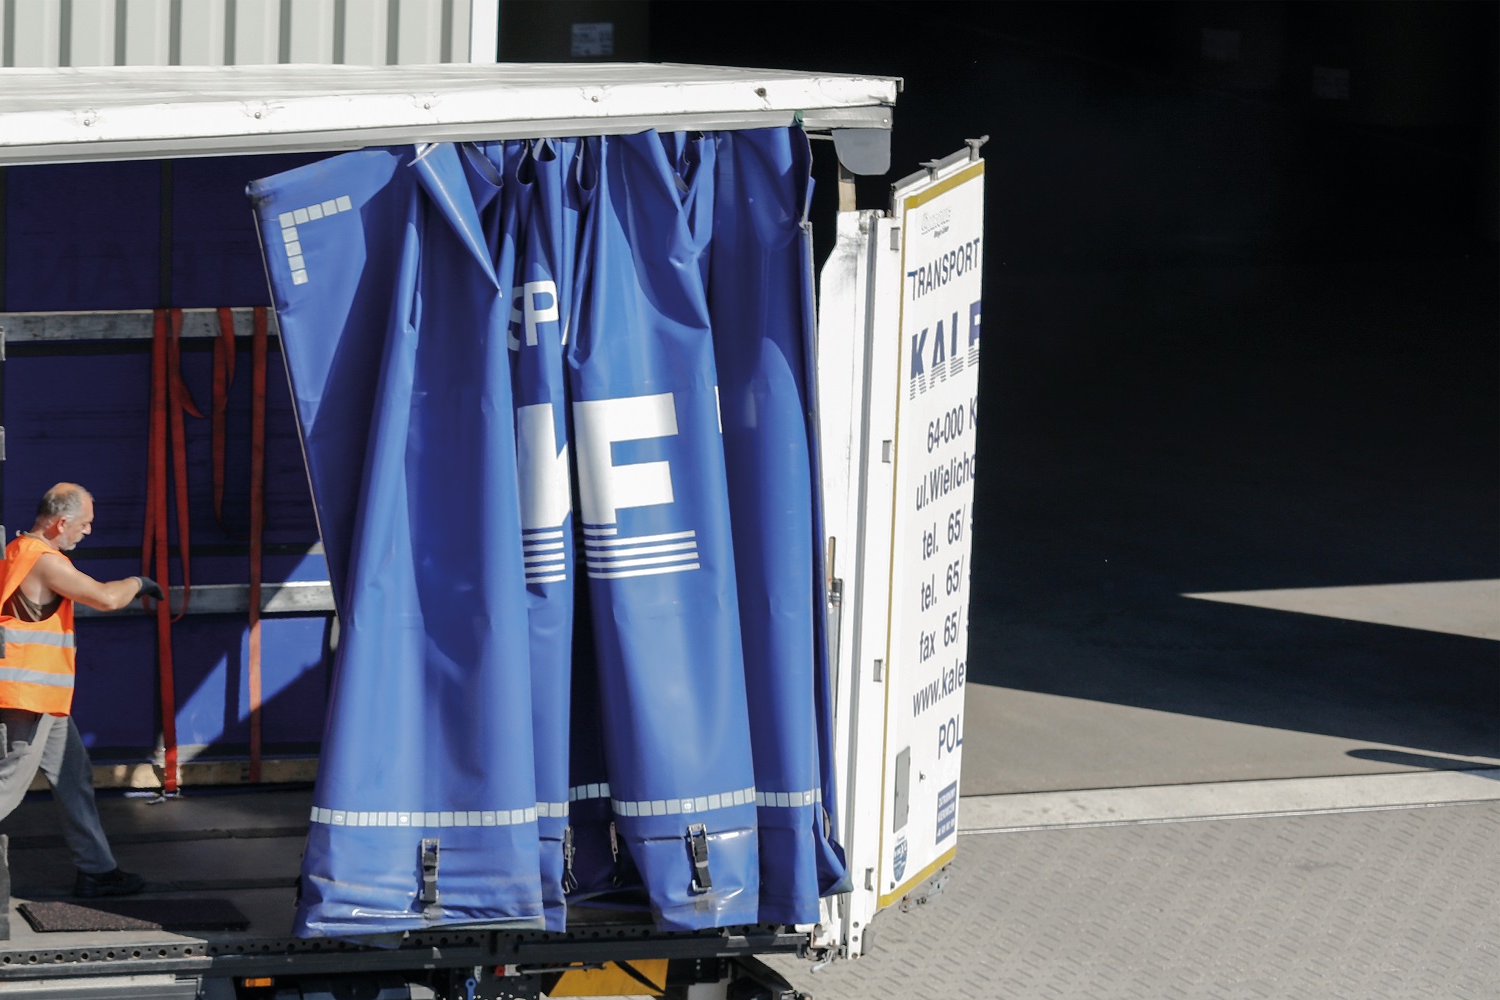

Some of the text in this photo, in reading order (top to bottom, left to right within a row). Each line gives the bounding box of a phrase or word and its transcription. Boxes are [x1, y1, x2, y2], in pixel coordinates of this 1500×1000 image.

[907, 236, 980, 302] TRANSPORT
[927, 404, 964, 454] 64-000
[922, 503, 966, 561] tel. 65/
[920, 554, 964, 613] tel. 65/
[919, 605, 962, 663] fax 65/
[913, 658, 967, 718] www.kale
